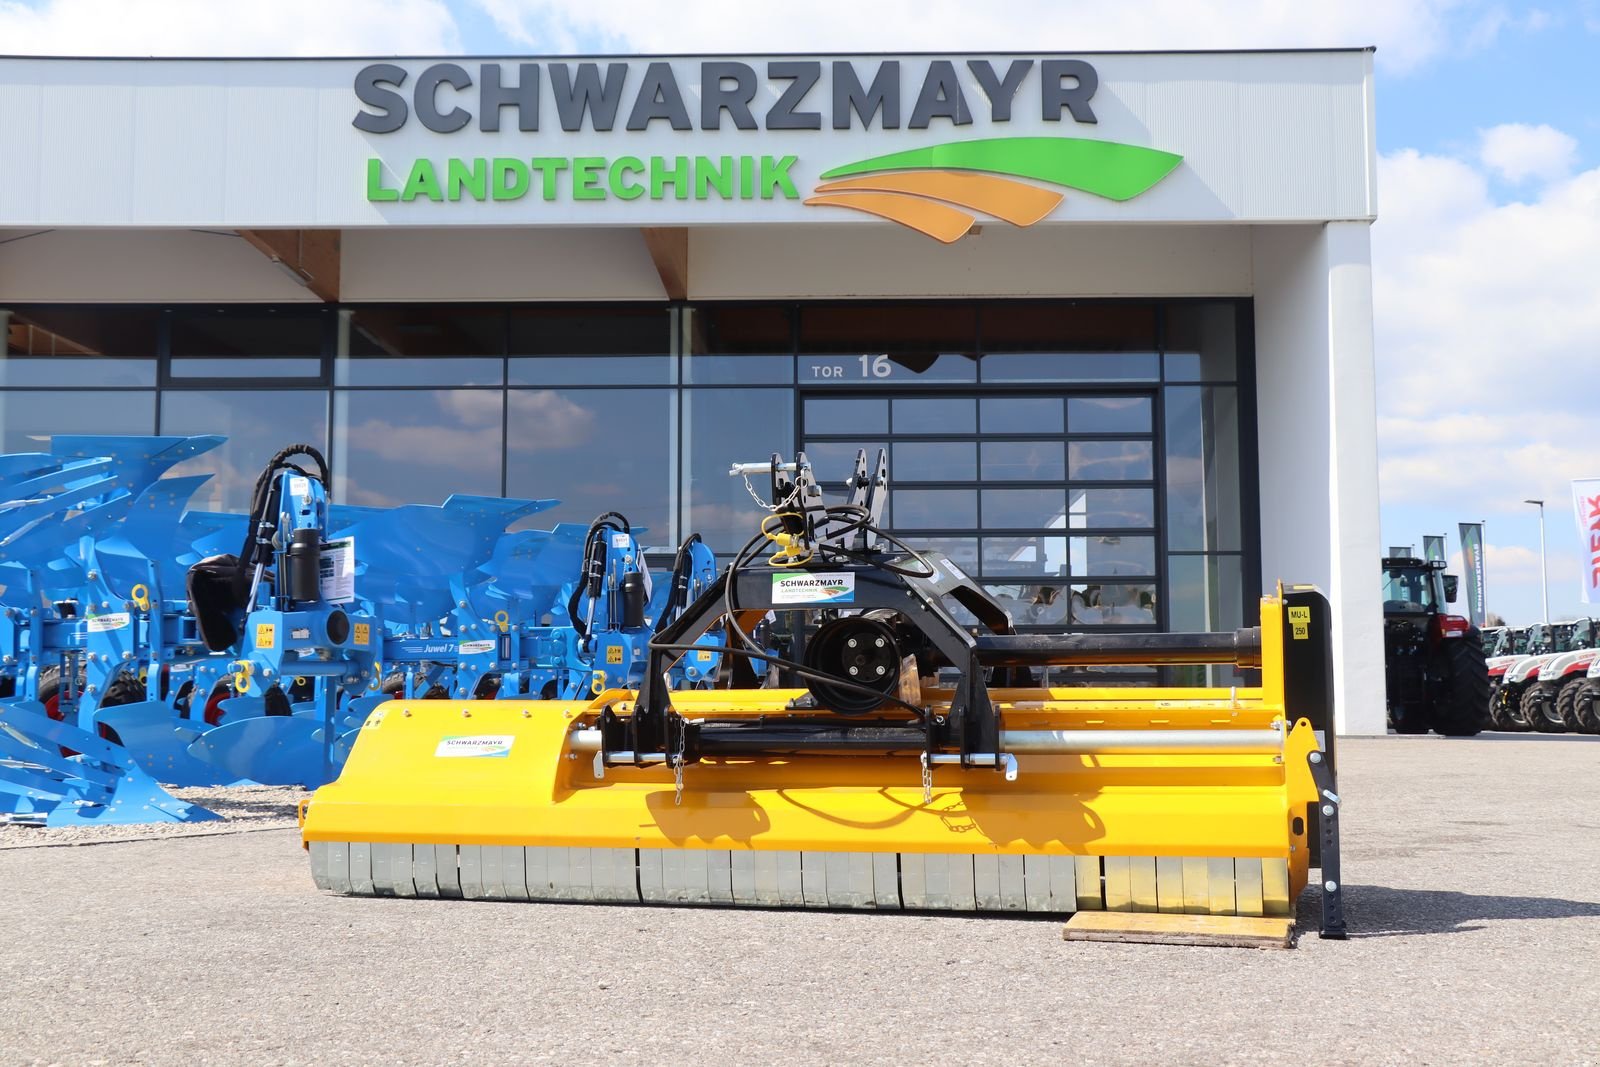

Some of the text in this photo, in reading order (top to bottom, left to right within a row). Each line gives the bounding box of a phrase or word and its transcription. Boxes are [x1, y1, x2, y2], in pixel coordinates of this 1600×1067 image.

[351, 59, 1099, 134] SCHWARZMAYR
[367, 155, 800, 202] LANDTECHNIK
[811, 354, 892, 377] TOR 16
[1291, 610, 1308, 618] MU-L
[1295, 627, 1306, 635] 250
[423, 643, 454, 653] Juwel 7
